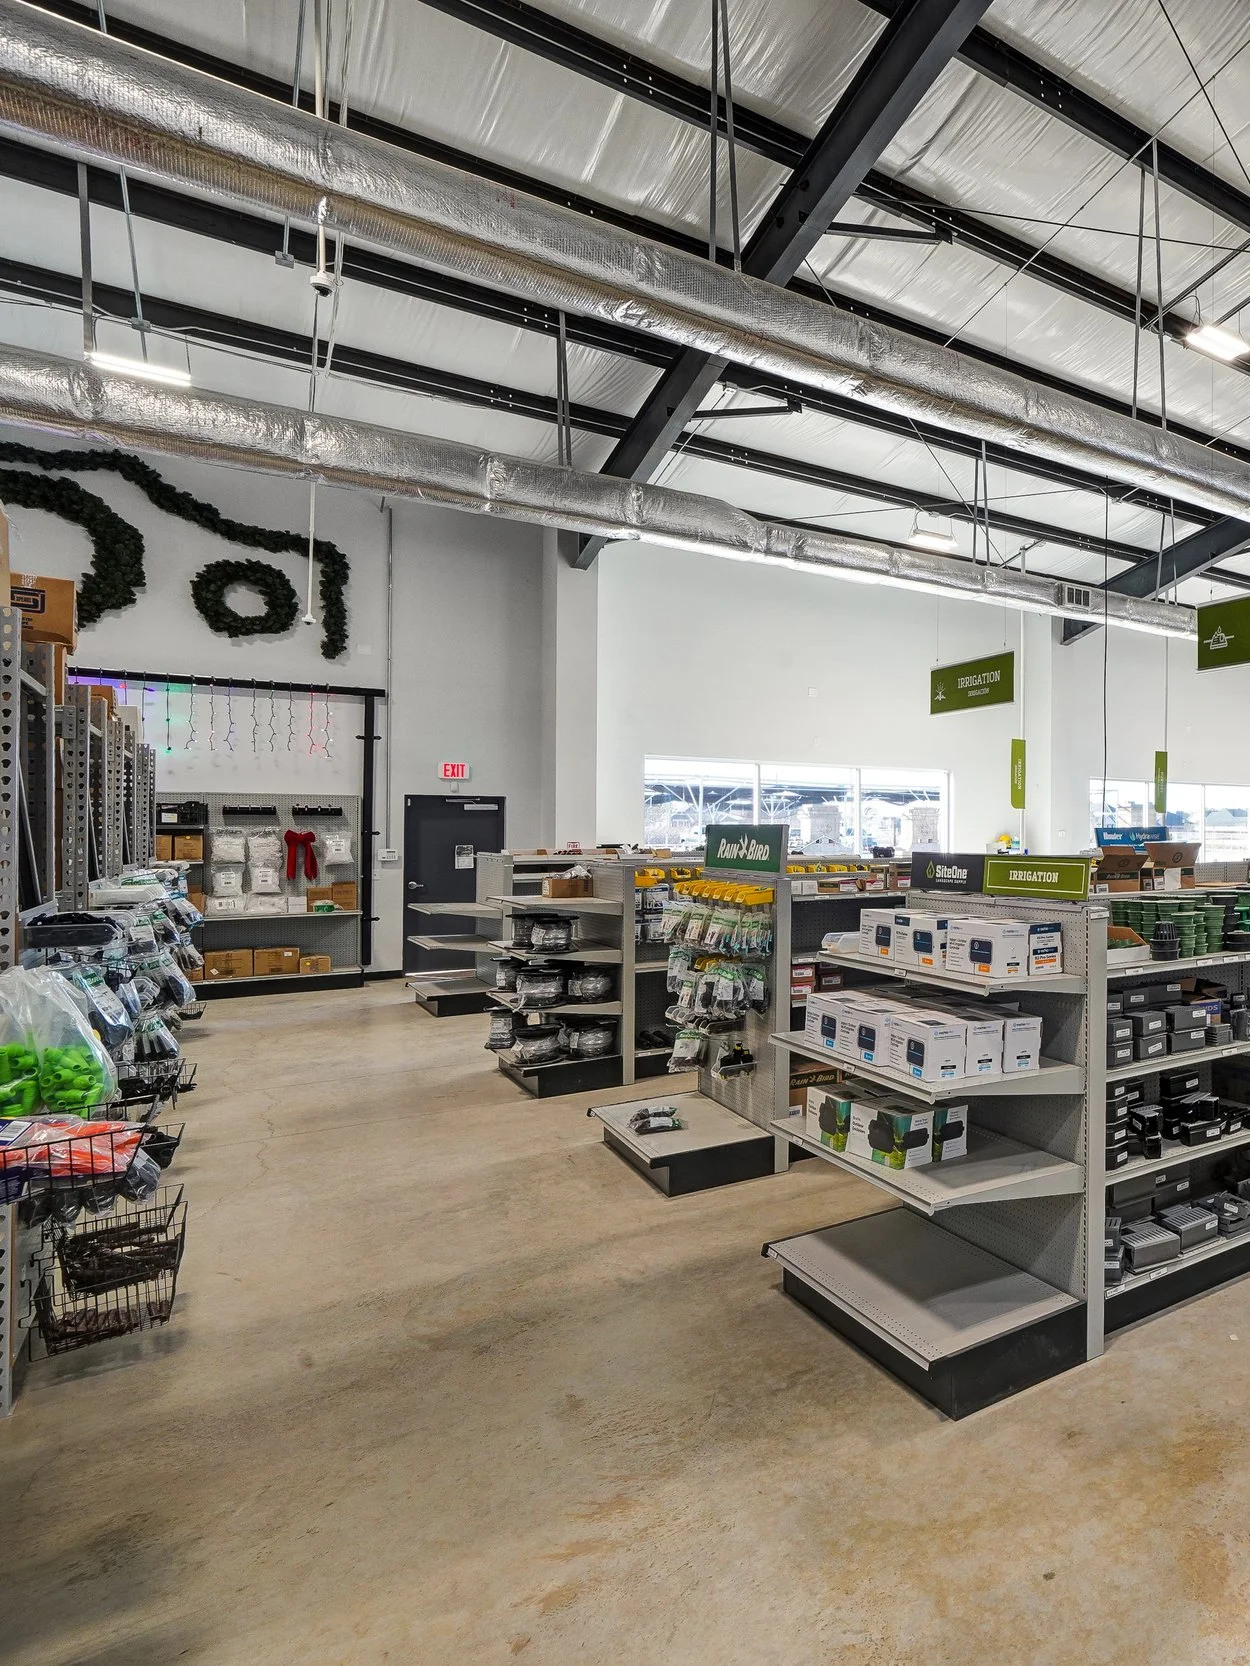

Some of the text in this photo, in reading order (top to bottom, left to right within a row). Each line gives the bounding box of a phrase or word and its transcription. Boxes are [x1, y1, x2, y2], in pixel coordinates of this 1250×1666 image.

[957, 670, 1001, 689] IRRIGATION
[443, 763, 466, 777] EXIT
[717, 838, 770, 861] RAIN BIRD
[935, 865, 967, 879] SiteOne
[1009, 870, 1059, 883] IRRIGATION
[814, 1074, 835, 1082] BIRD
